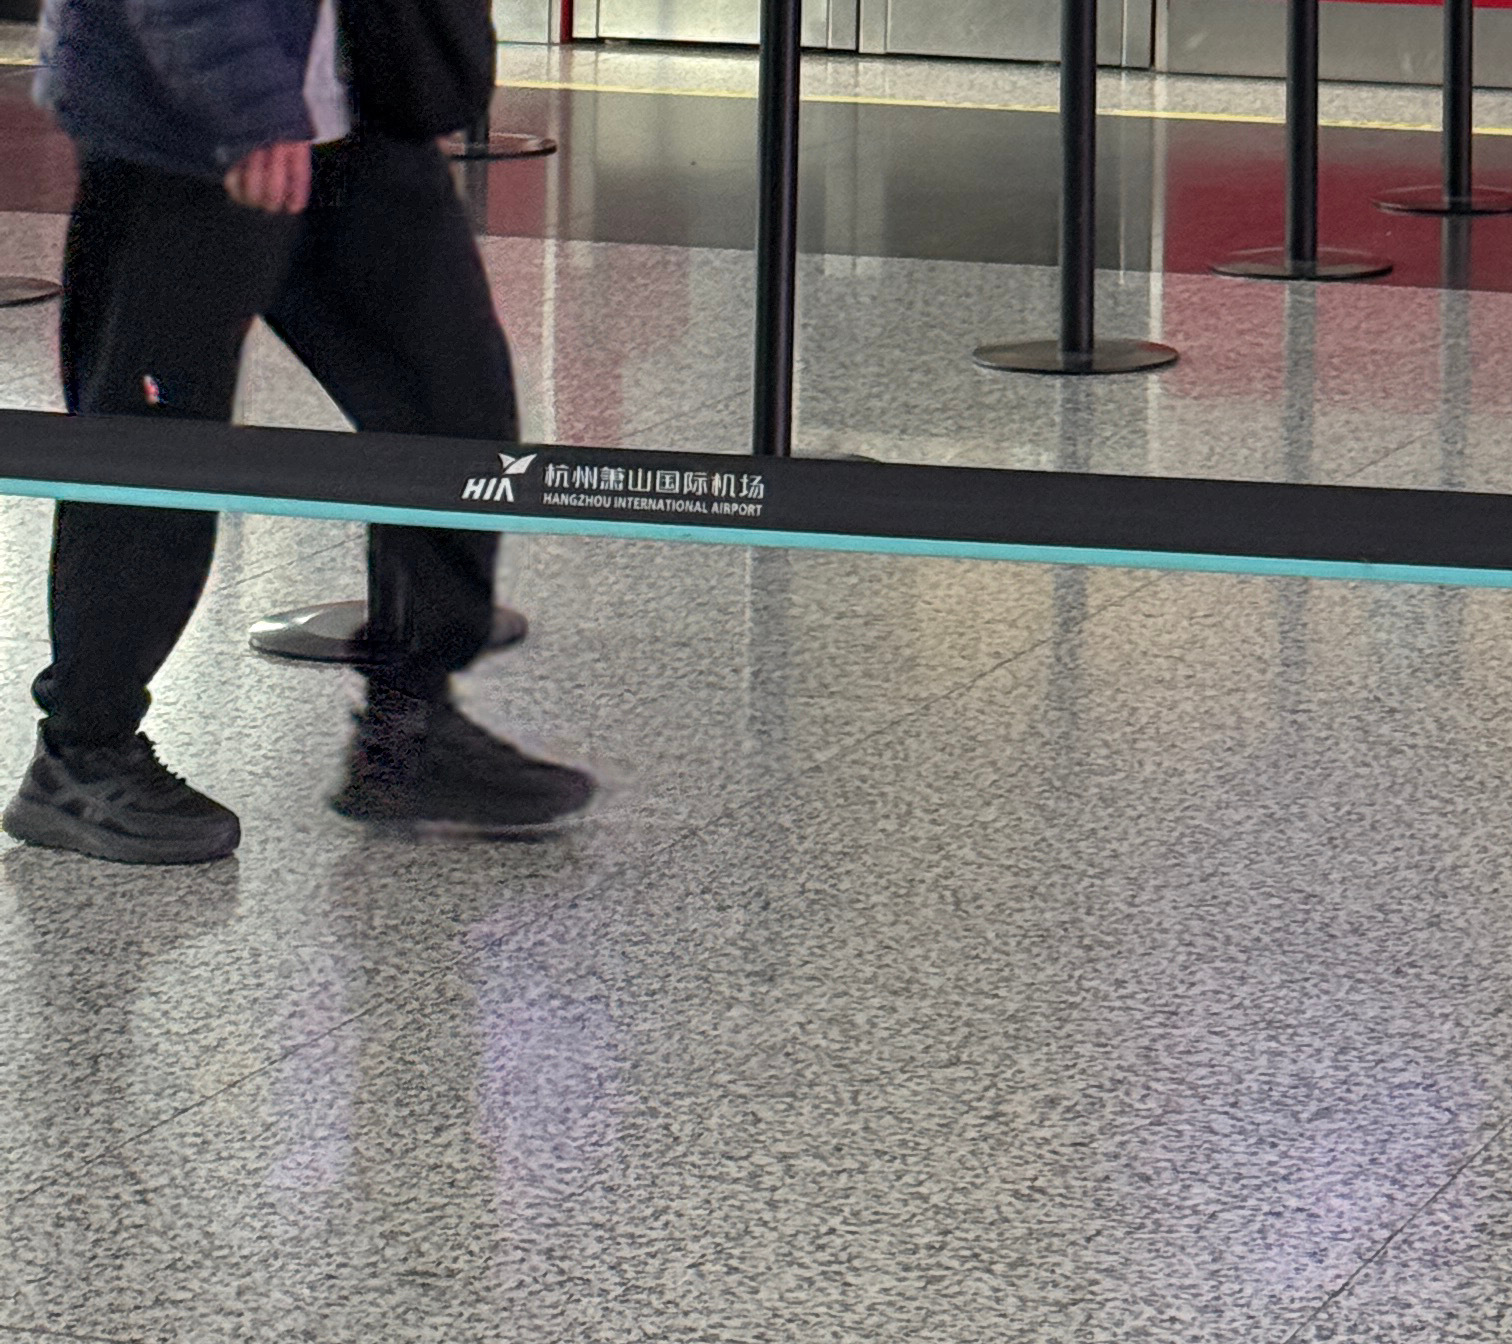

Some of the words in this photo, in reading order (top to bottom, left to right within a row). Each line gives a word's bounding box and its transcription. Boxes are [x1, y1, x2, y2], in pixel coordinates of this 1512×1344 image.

[543, 463, 765, 500] 杭州萧山国际机场
[542, 492, 612, 508] HANGZHOU
[614, 495, 708, 514] INTERNATIONAL
[711, 502, 763, 517] AIRPORT
